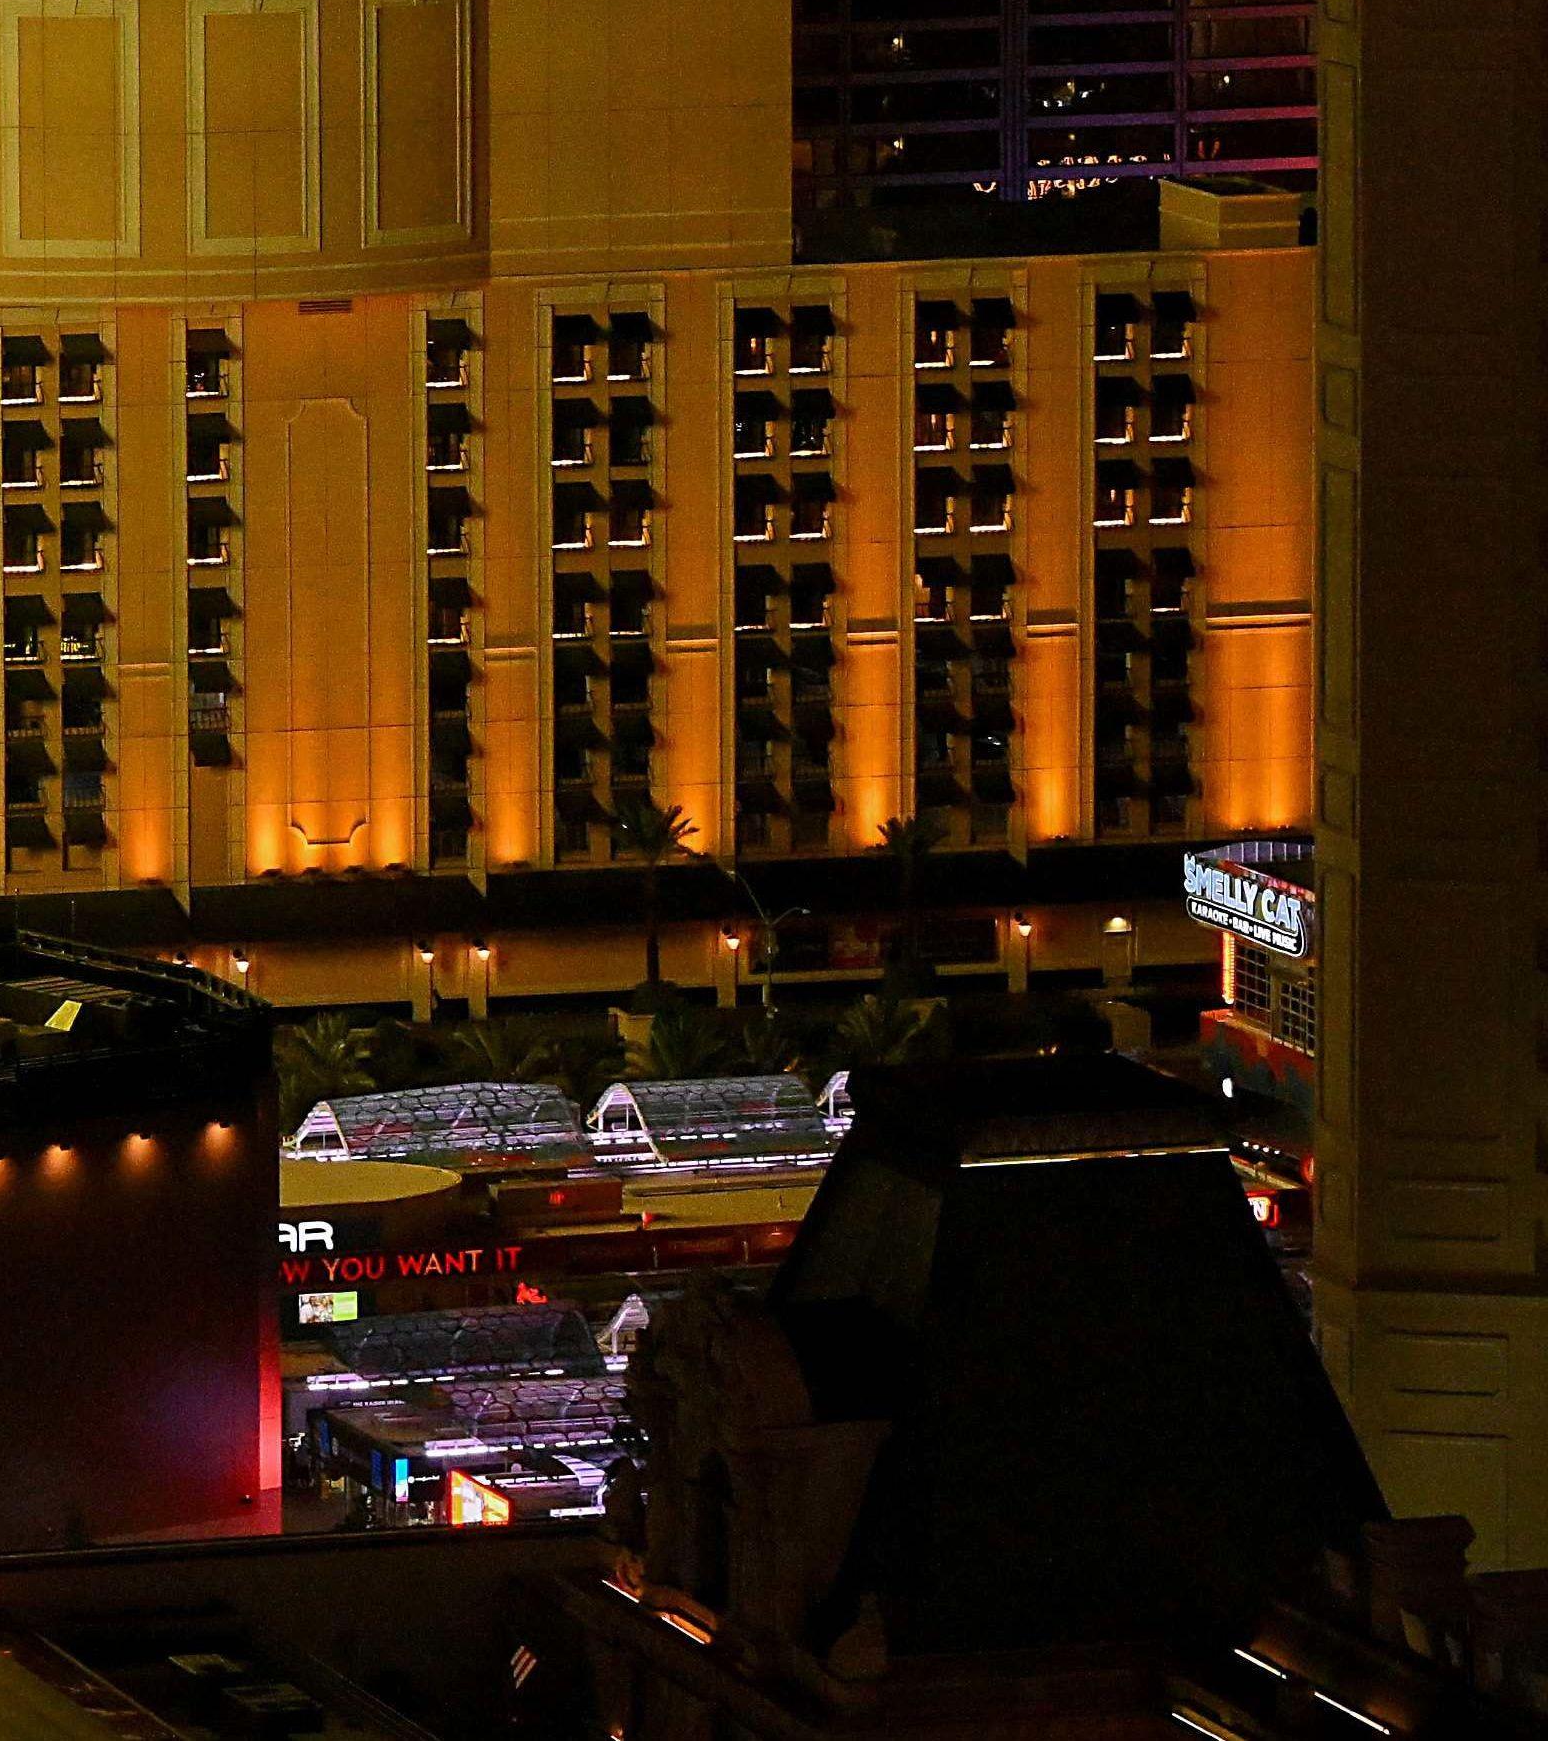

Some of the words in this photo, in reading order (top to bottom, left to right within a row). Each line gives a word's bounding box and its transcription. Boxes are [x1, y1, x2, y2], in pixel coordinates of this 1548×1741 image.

[1184, 854, 1257, 914] SMELLY
[1261, 889, 1301, 935] CAT
[1191, 900, 1229, 927] KARAOKE
[1254, 923, 1271, 941] LIVE
[321, 1256, 386, 1282] YOU
[397, 1249, 484, 1277] WANT
[495, 1246, 524, 1272] IT
